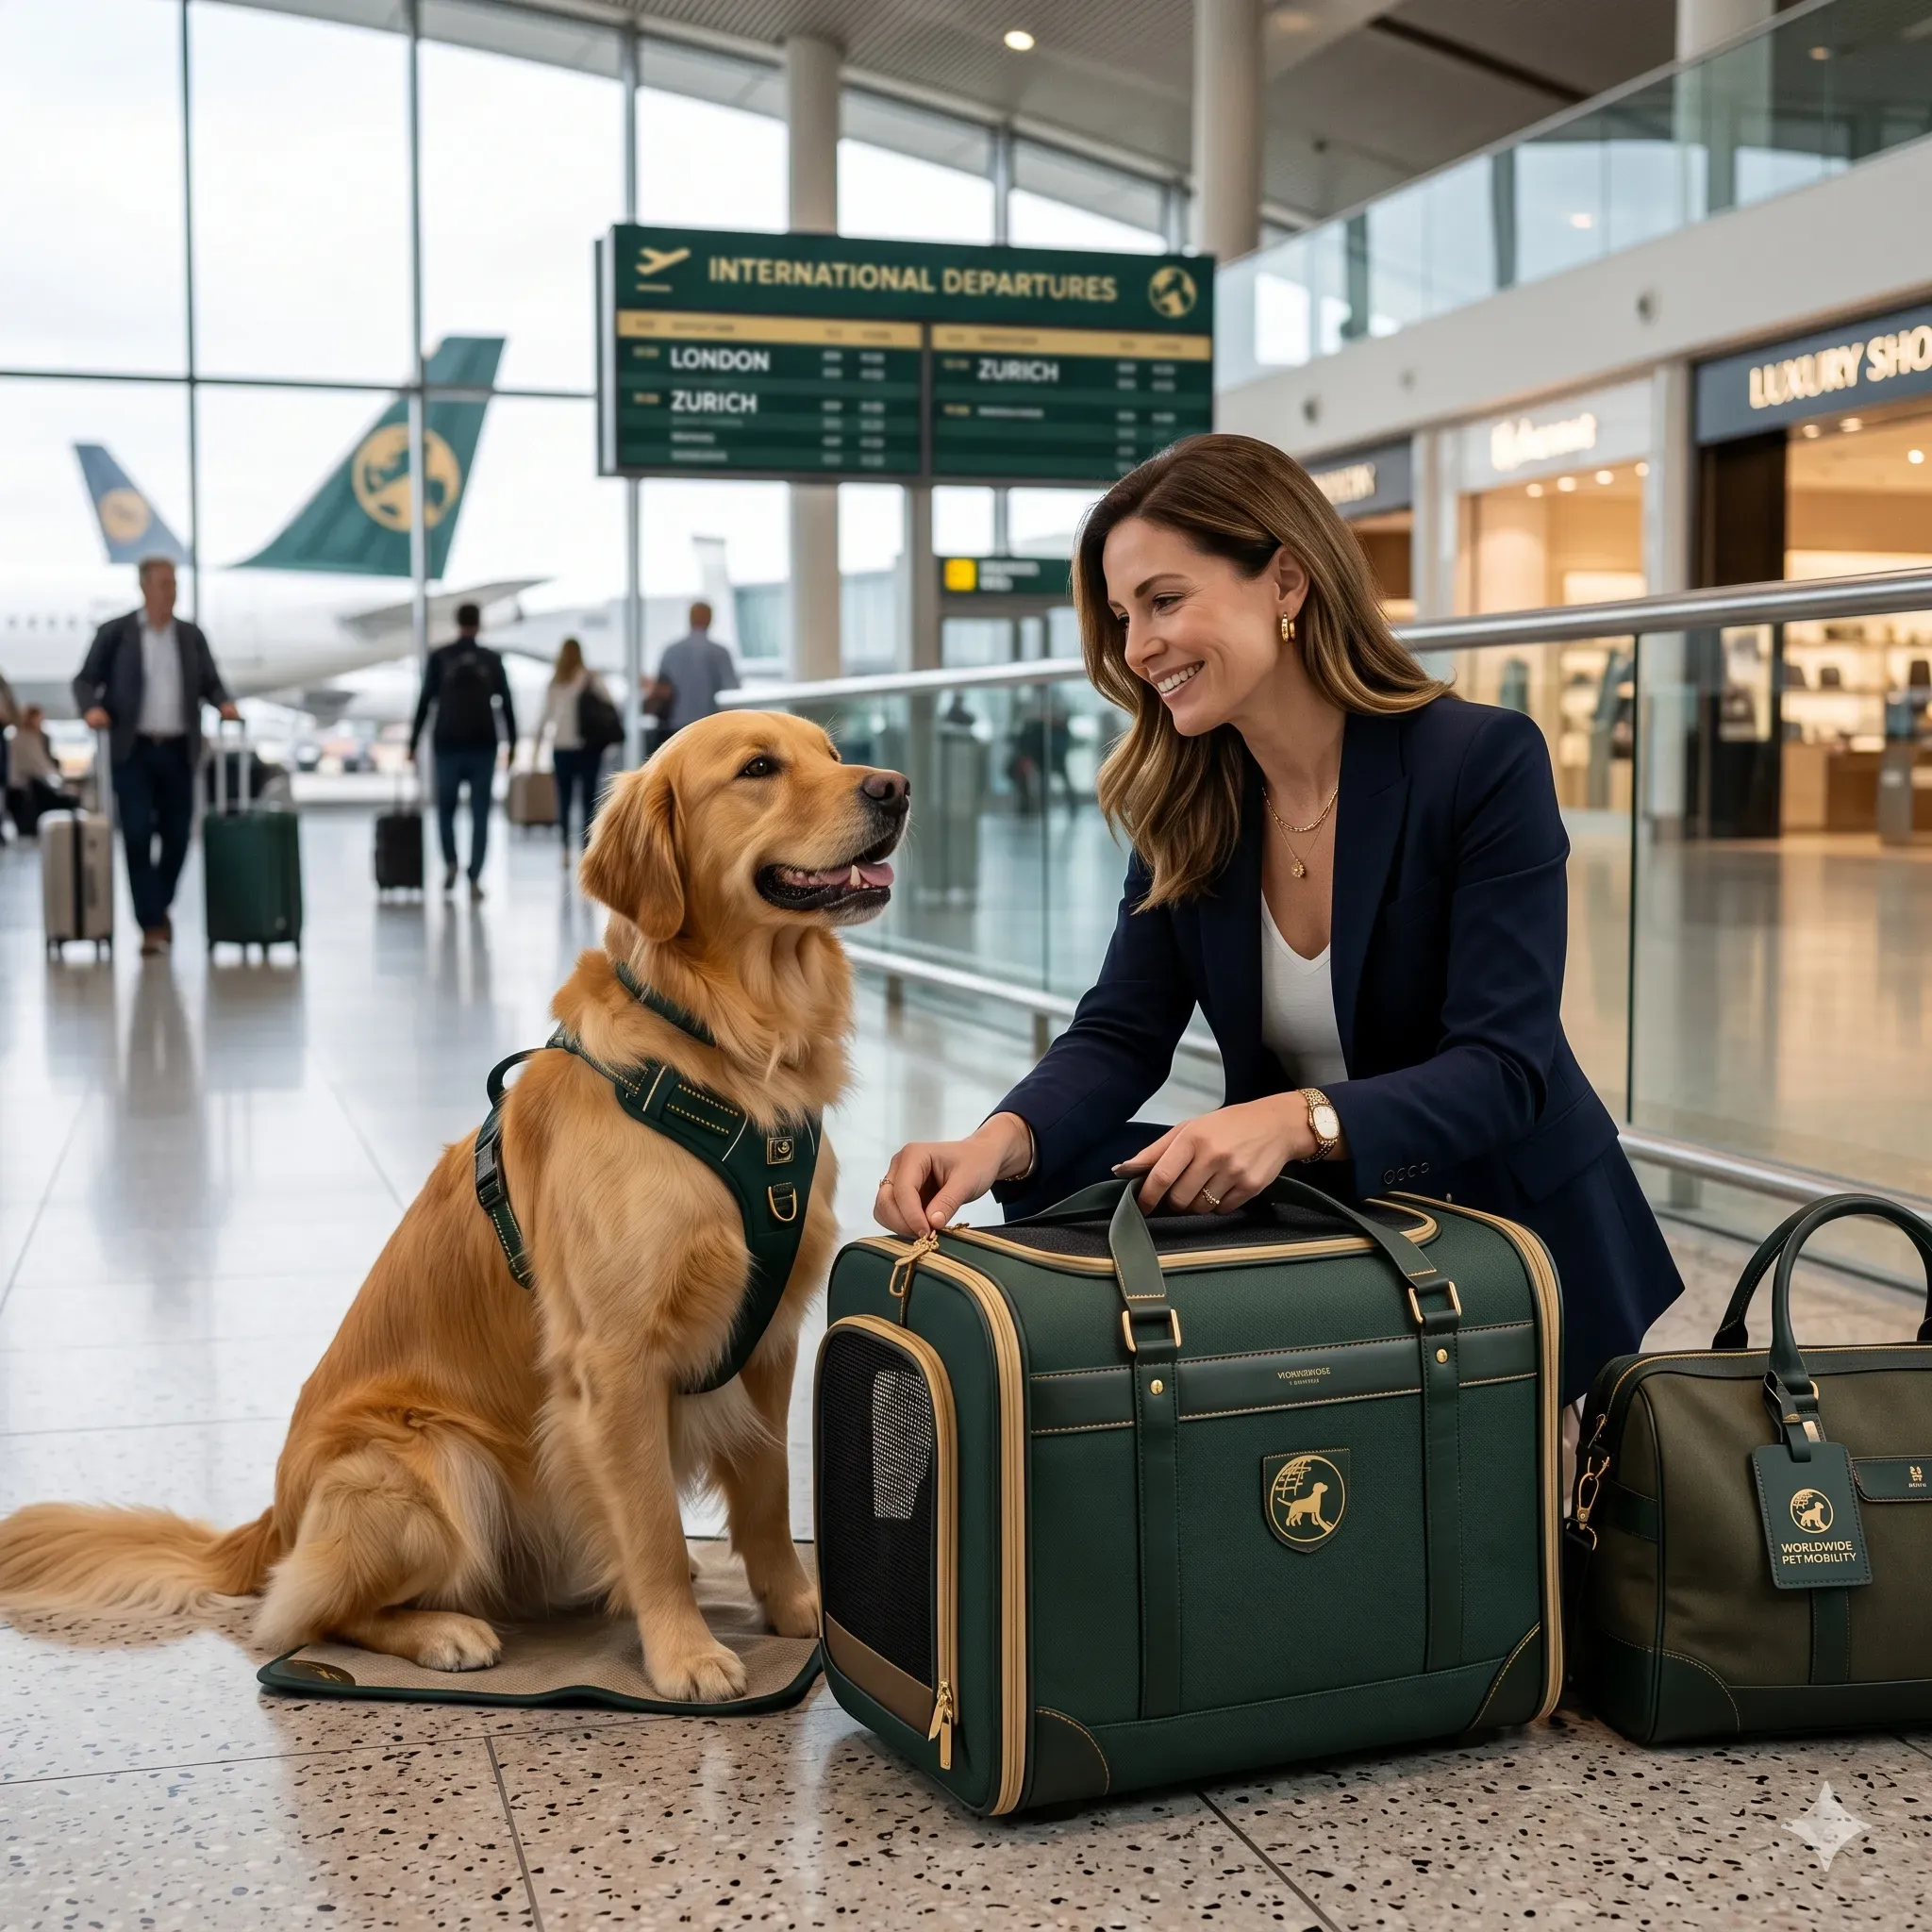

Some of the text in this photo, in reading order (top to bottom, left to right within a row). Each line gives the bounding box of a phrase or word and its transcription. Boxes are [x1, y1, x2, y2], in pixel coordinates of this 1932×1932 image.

[708, 256, 1119, 303] INTERNATIONAL DEPARTURES
[670, 346, 770, 371] LONDON
[977, 358, 1059, 382] ZURICH
[1749, 341, 1865, 408] LUXURY
[670, 390, 758, 413] ZURICH
[1781, 1541, 1853, 1554] WORLDWIDE
[1782, 1553, 1857, 1565] PET MOBILITY
